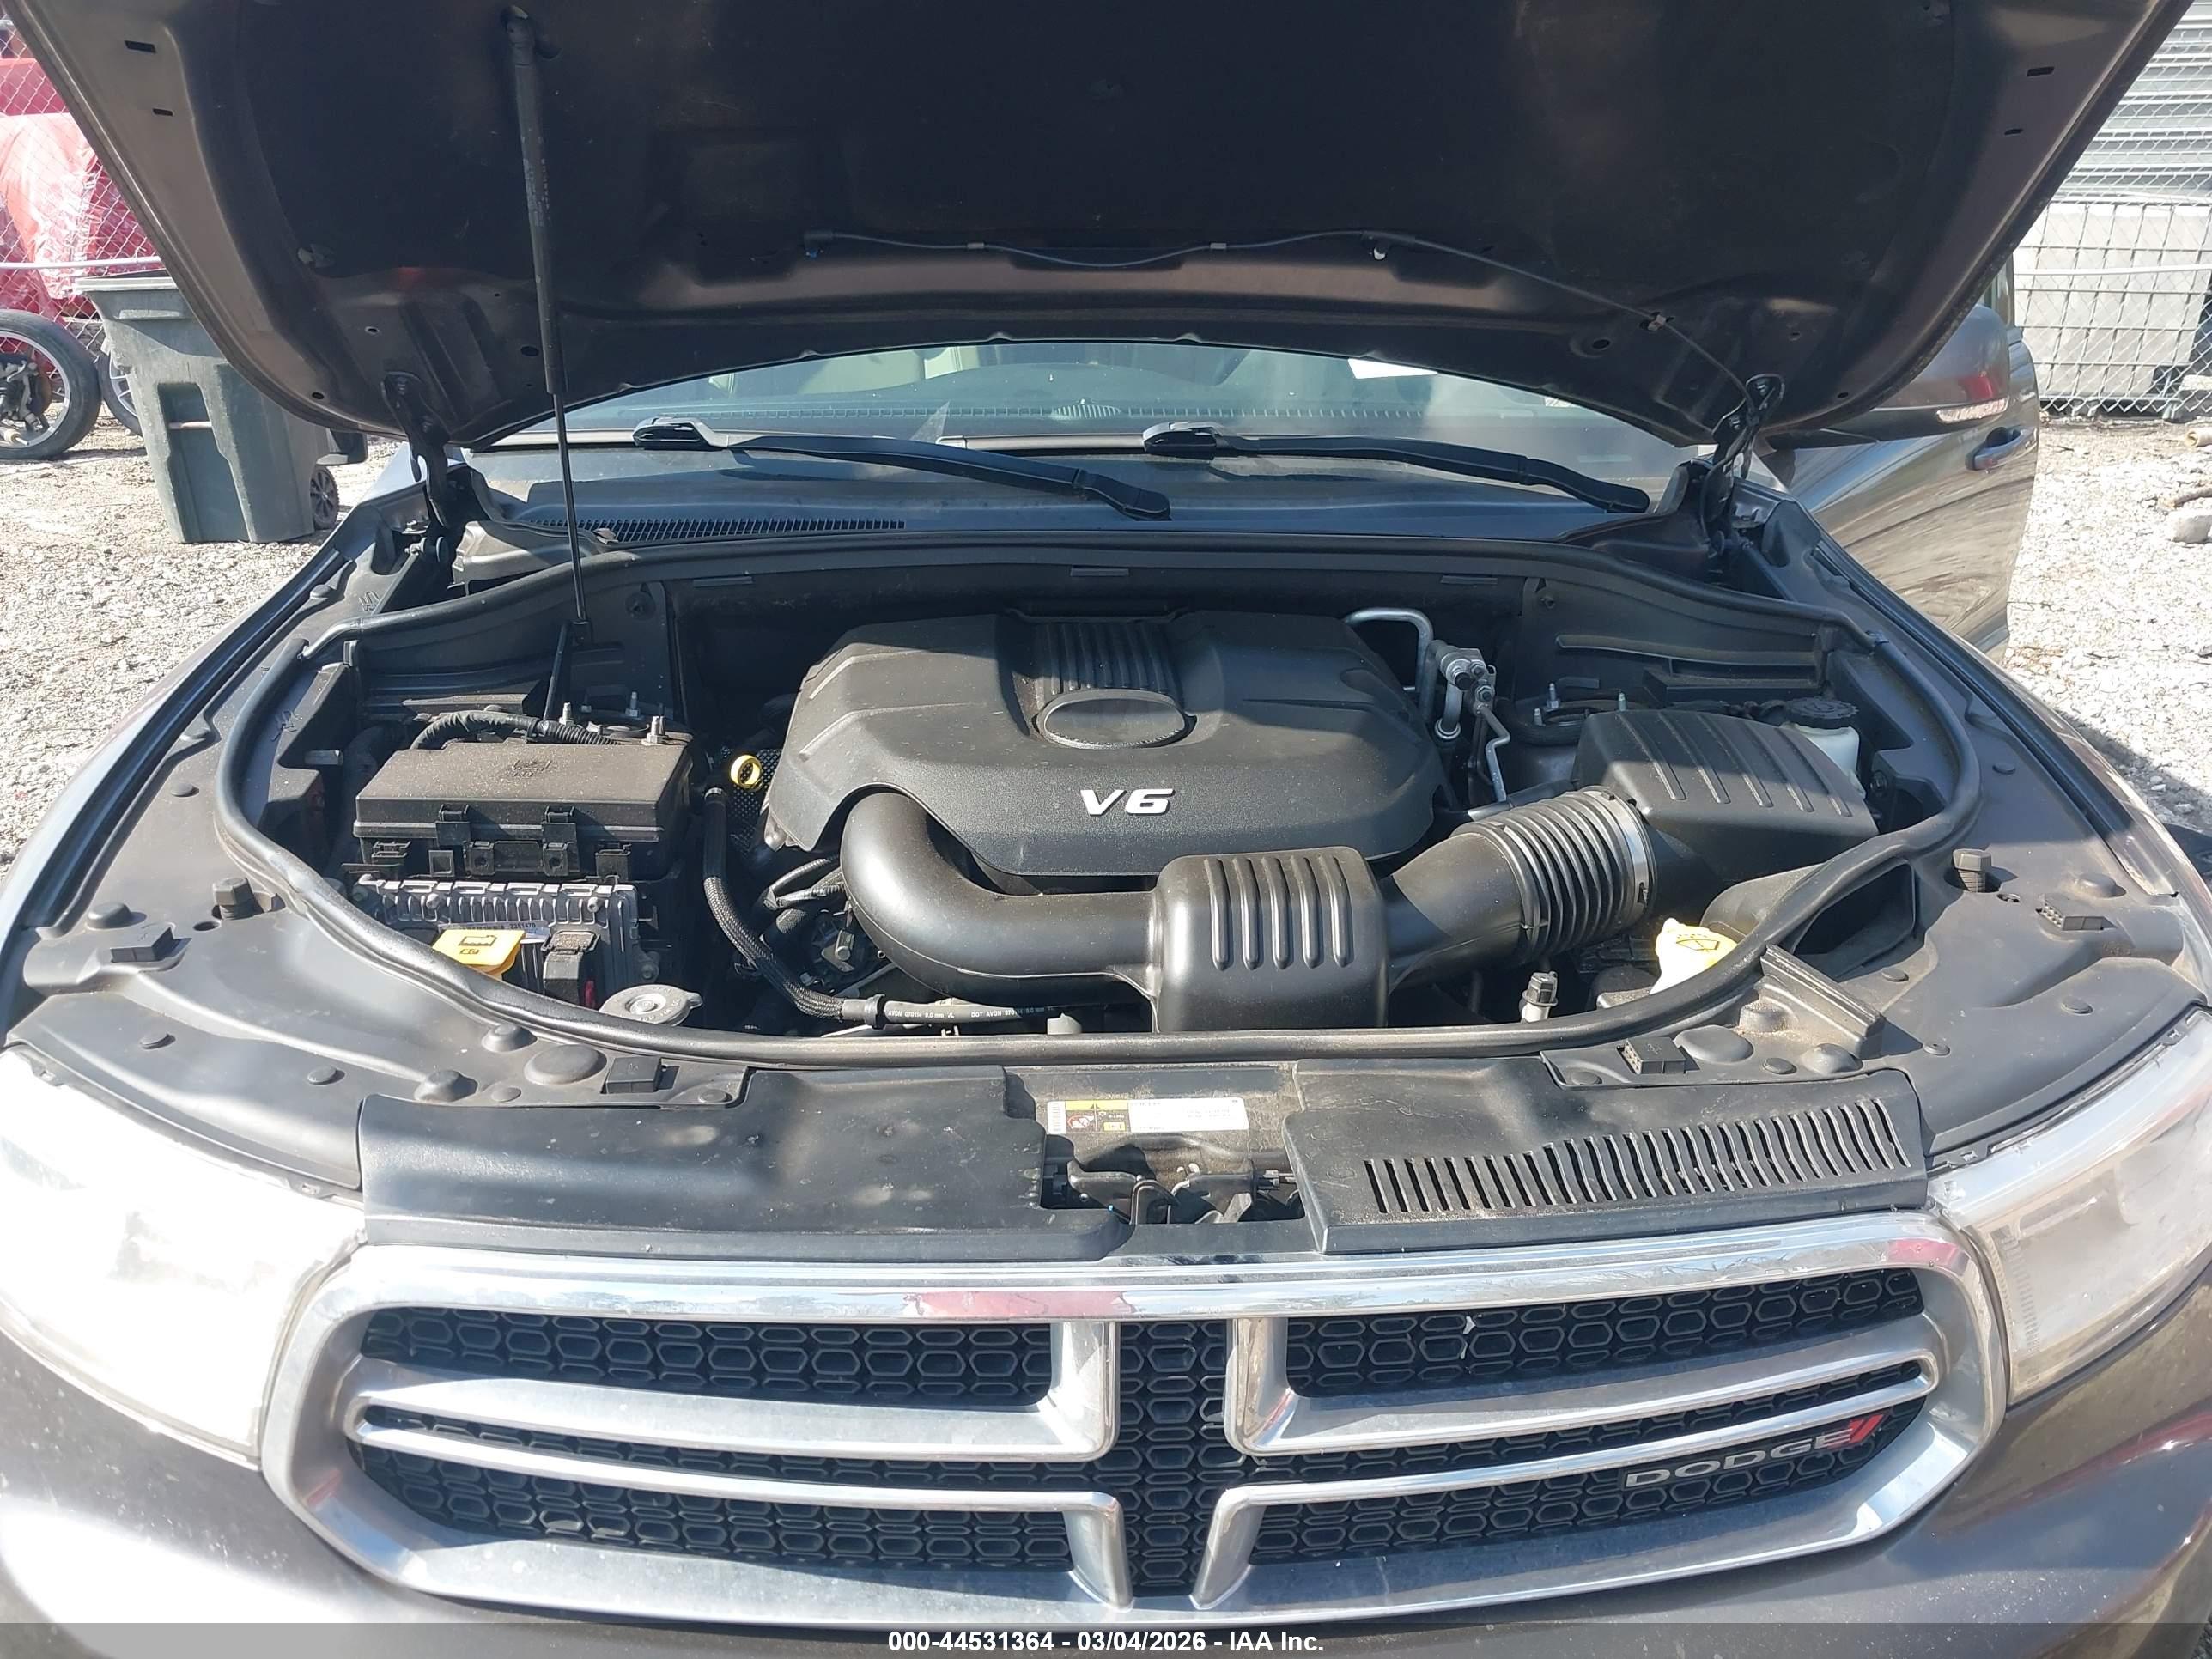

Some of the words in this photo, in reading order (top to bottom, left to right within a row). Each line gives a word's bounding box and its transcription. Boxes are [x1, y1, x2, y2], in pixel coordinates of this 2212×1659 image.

[1080, 788, 1176, 817] V6
[888, 1009, 902, 1018] AVON
[986, 1009, 1002, 1018] AVON
[1626, 1427, 1855, 1488] DODGE
